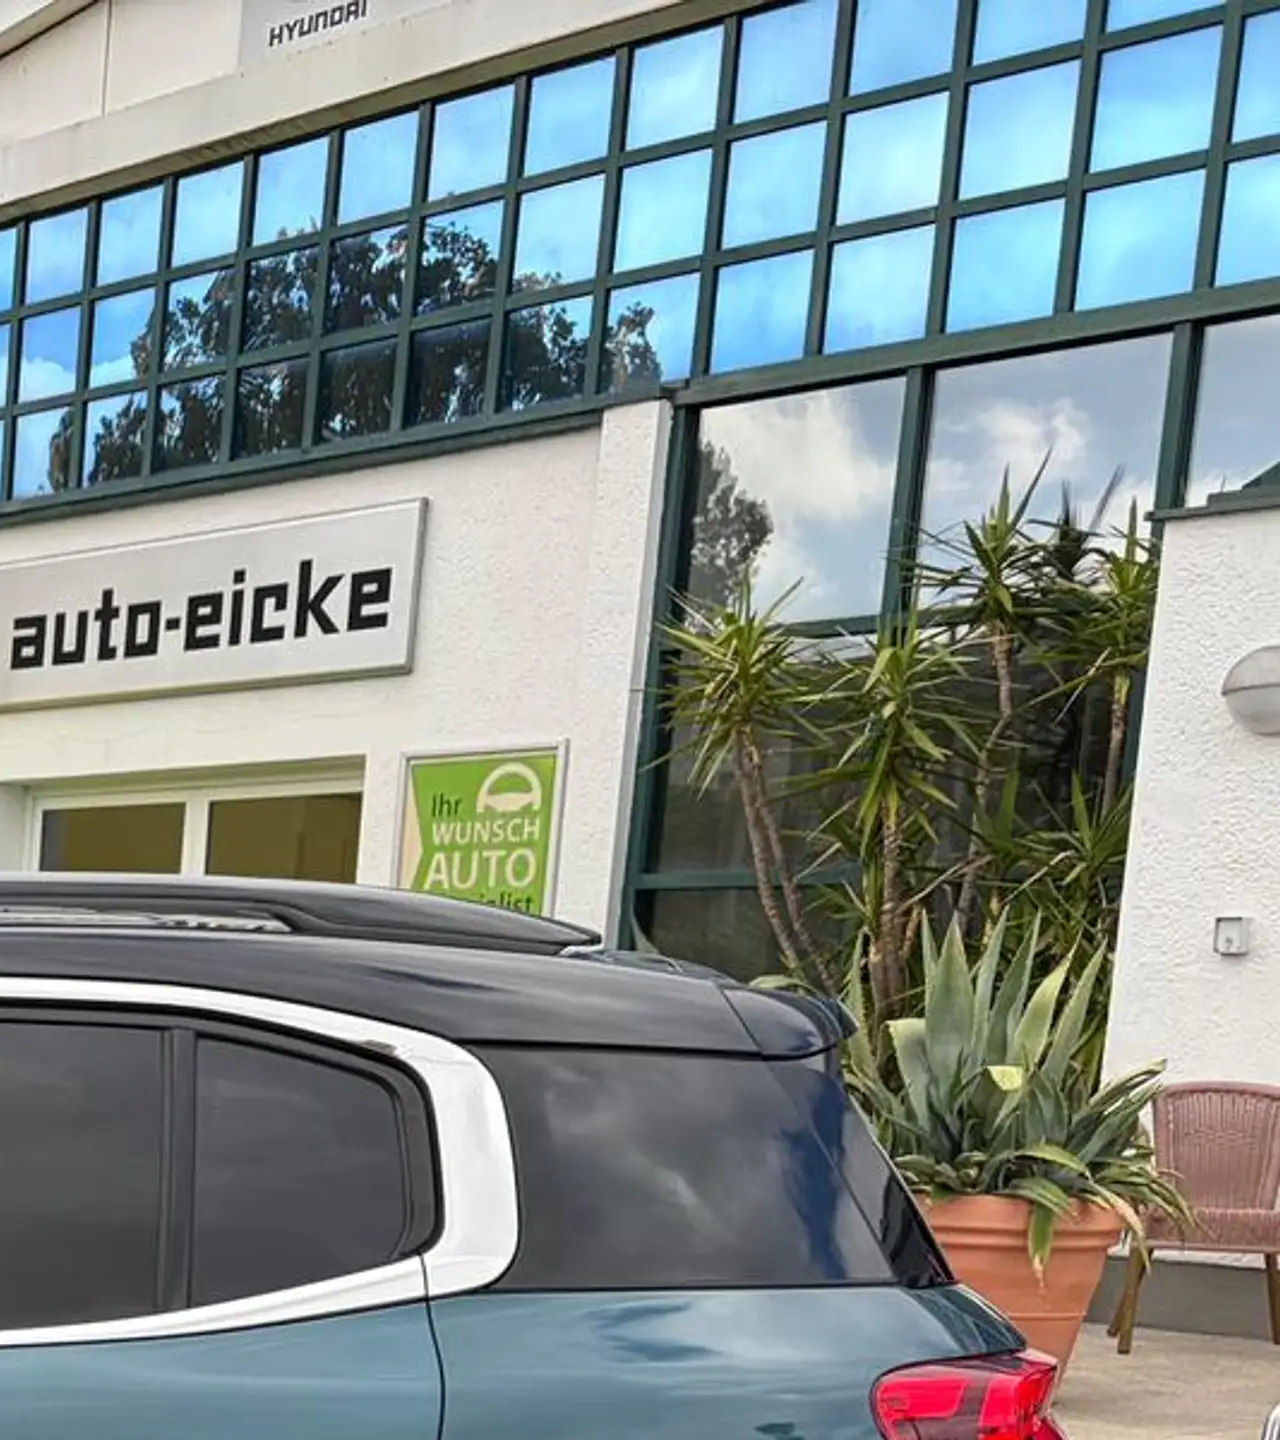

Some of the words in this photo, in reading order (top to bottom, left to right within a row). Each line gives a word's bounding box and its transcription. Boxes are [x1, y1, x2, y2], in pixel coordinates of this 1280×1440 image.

[268, 0, 368, 48] HYUNDAI
[10, 559, 393, 670] auto-eicke
[431, 793, 463, 818] Ihr
[431, 817, 541, 846] WUNSCH
[423, 847, 538, 890] AUTO
